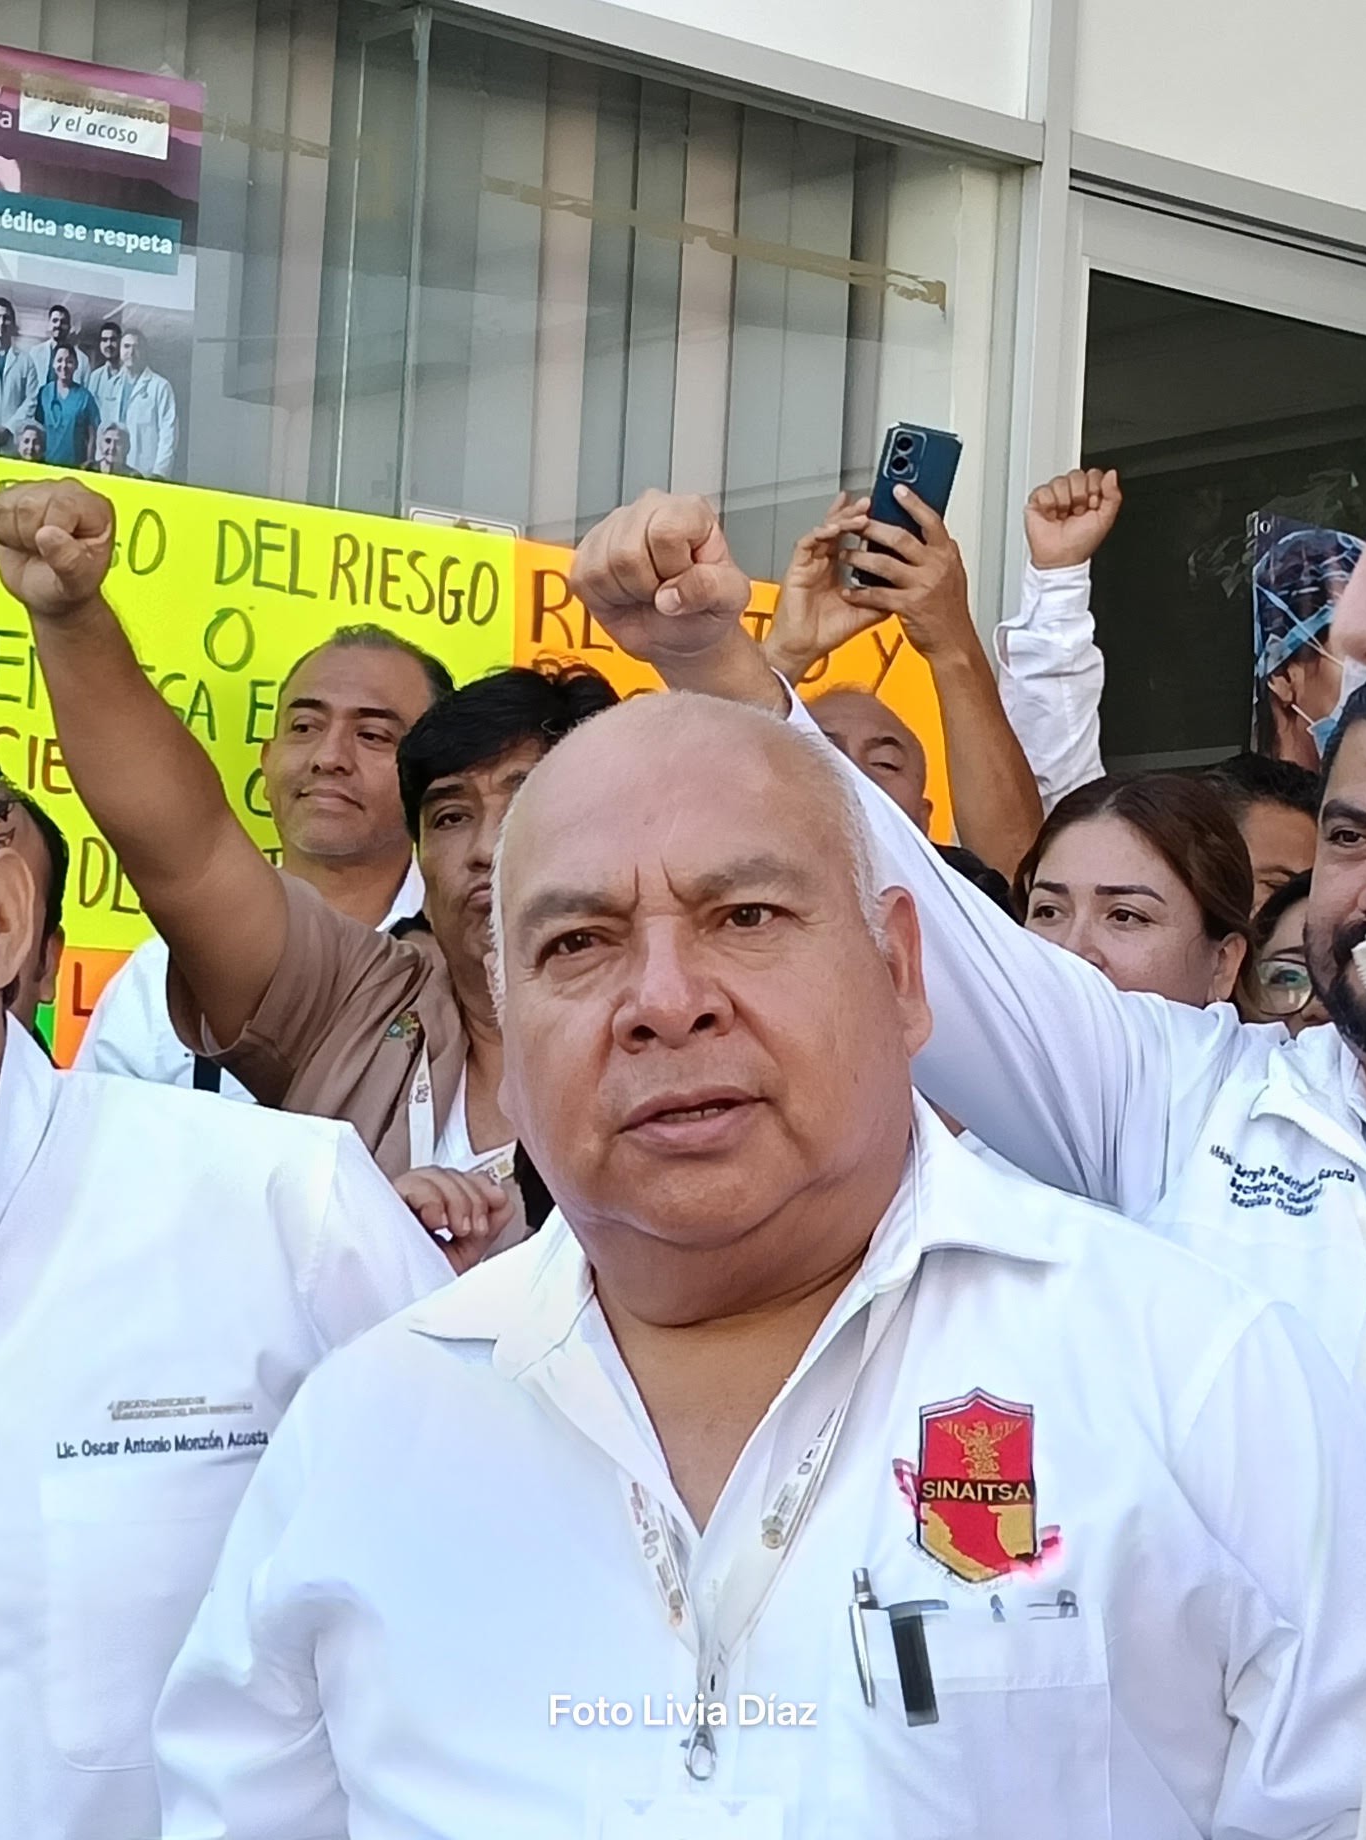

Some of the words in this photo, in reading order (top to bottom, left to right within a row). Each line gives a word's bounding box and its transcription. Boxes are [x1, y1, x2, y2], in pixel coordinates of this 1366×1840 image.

[48, 113, 61, 133] y
[65, 116, 81, 133] el
[85, 119, 138, 145] acoso
[63, 221, 87, 242] se
[93, 225, 174, 255] respeta
[214, 517, 319, 599] DEL
[329, 533, 502, 626] RIESGO
[56, 1441, 78, 1459] Lic.
[81, 1439, 119, 1457] Oscar
[124, 1436, 172, 1455] Antonio
[174, 1429, 224, 1452] Monzón
[227, 1430, 270, 1448] Acosta
[921, 1479, 1032, 1502] SINAITSA
